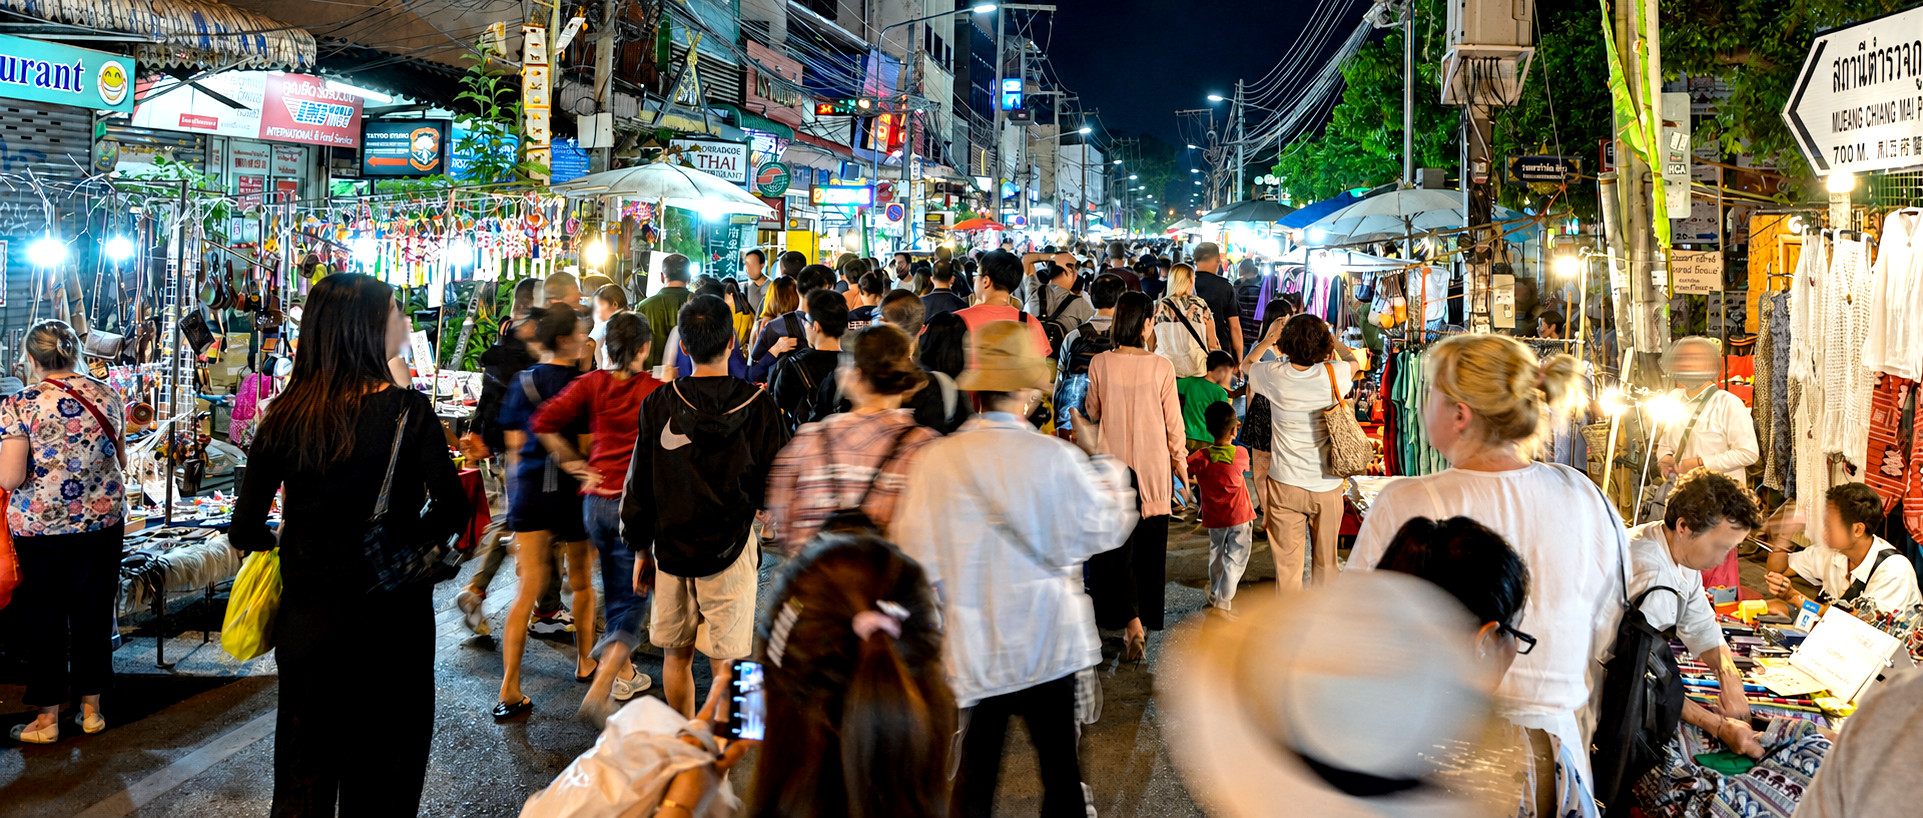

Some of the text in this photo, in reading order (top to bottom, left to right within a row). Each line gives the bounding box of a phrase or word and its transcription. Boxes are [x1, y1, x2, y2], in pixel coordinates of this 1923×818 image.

[1832, 106, 1863, 133] MUEANG
[1866, 100, 1896, 128] CHIANG
[1899, 97, 1914, 122] MAI
[697, 154, 736, 171] THAI
[1833, 144, 1854, 164] 700
[1668, 165, 1686, 174] HCA
